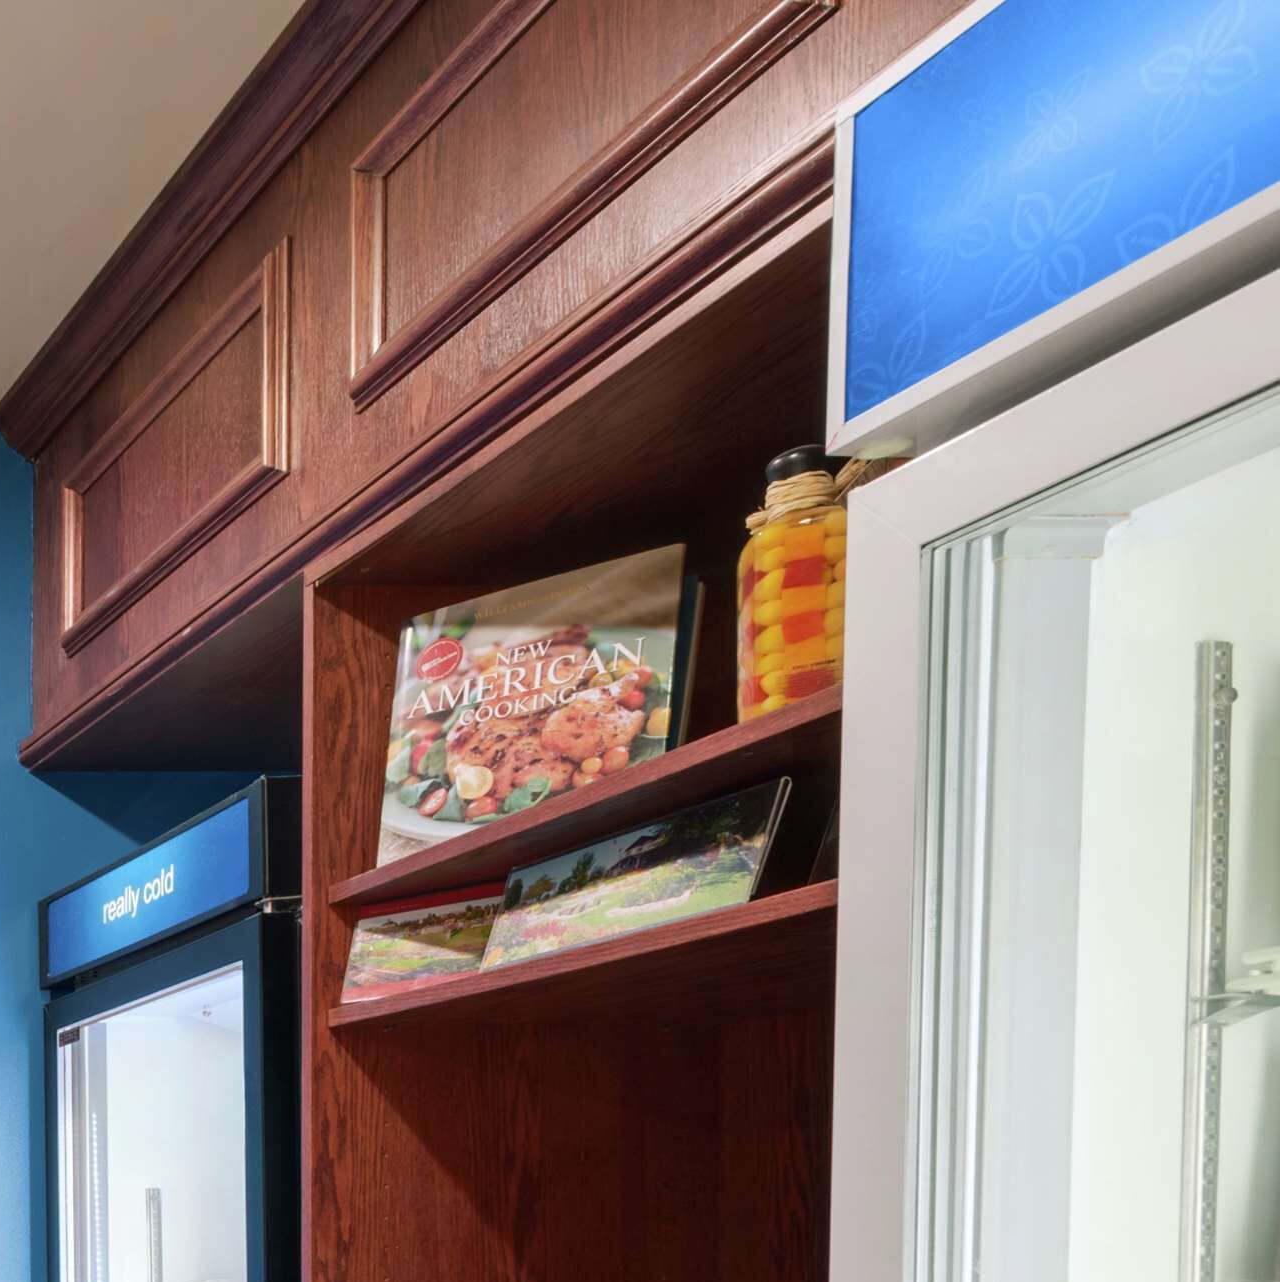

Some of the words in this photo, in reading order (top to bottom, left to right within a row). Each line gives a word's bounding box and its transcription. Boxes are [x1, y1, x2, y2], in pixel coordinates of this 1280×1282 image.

[496, 639, 554, 666] NEW
[408, 637, 646, 719] AMERICAN
[459, 687, 577, 726] COOKING
[103, 884, 140, 925] really
[143, 863, 175, 904] cold
